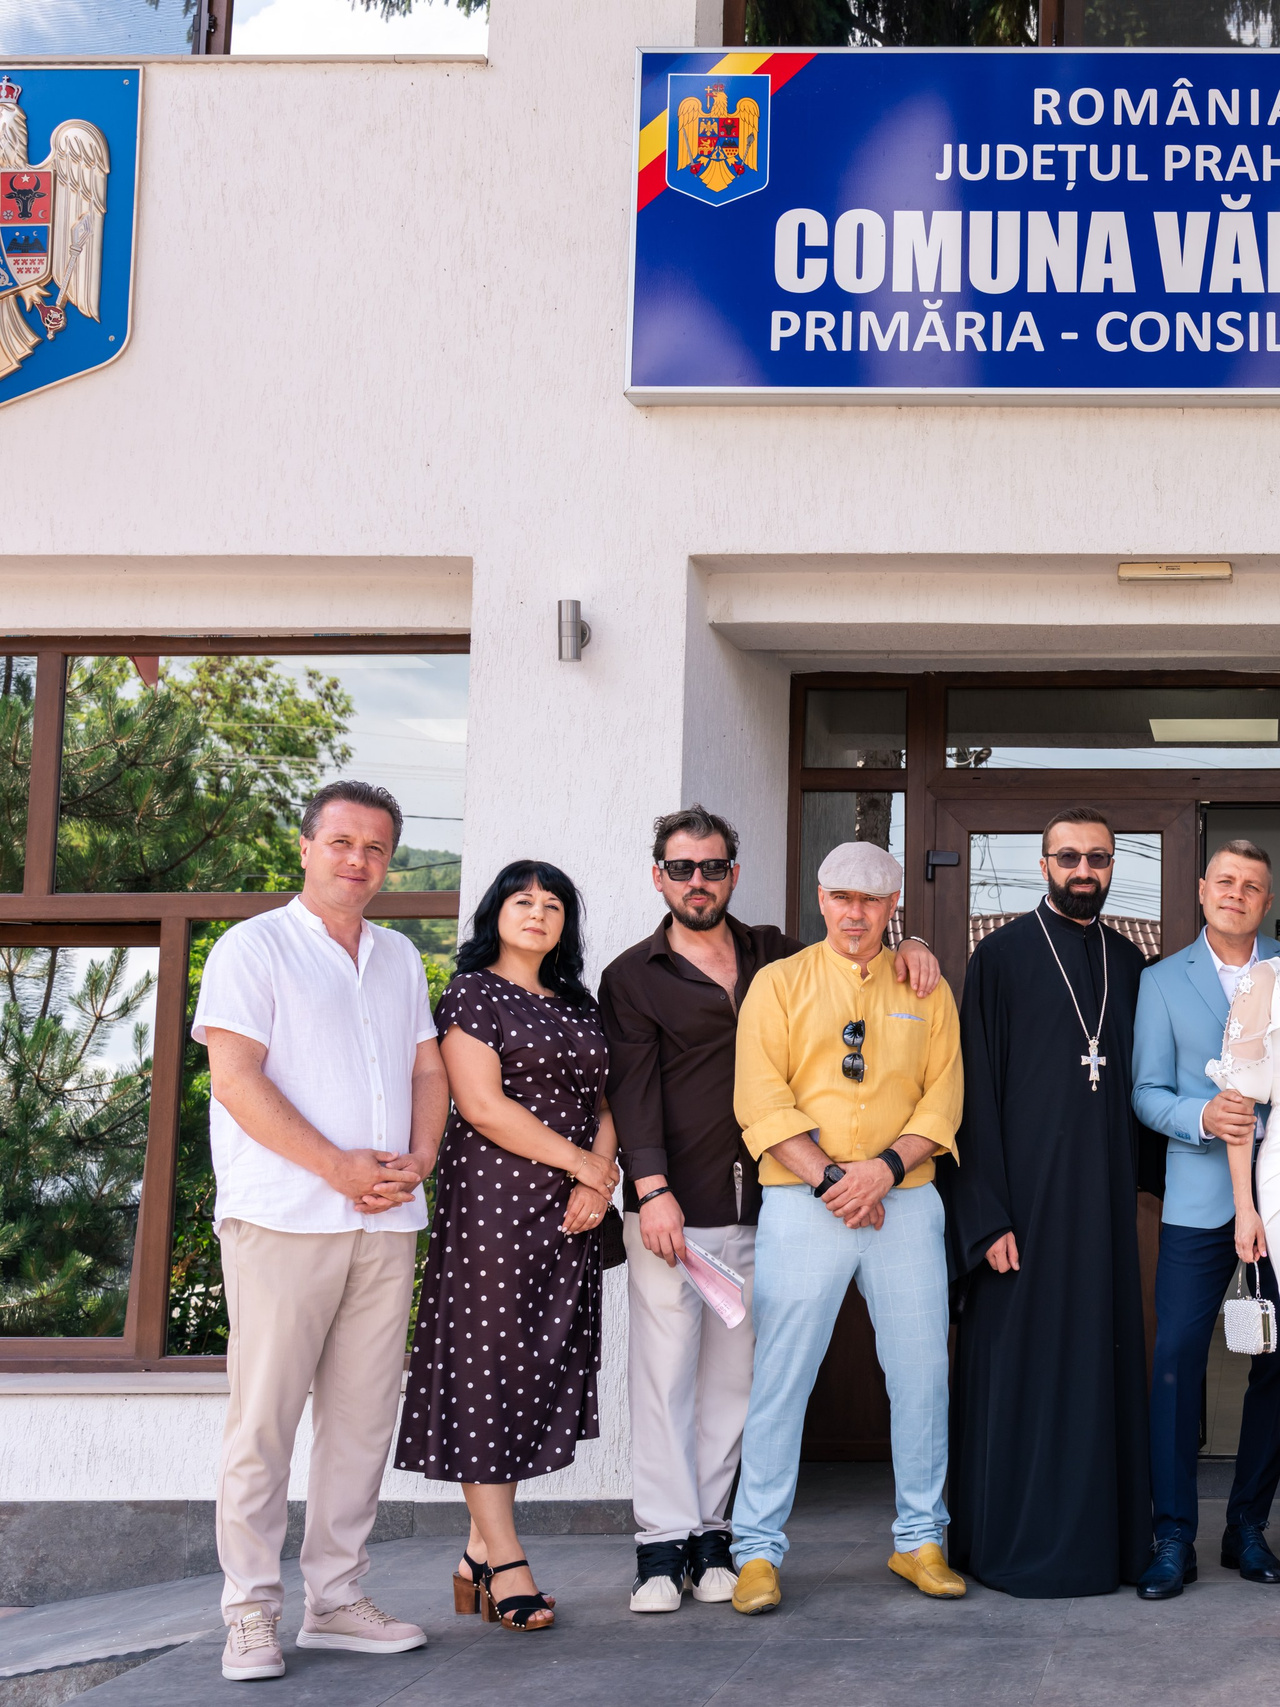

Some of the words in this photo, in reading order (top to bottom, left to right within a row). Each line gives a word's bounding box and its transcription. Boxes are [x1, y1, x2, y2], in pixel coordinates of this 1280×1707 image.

[936, 144, 1148, 190] JUDEȚUL
[774, 208, 1136, 295] COMUNA
[770, 299, 1045, 352] PRIMĂRIA
[1061, 332, 1079, 340] -
